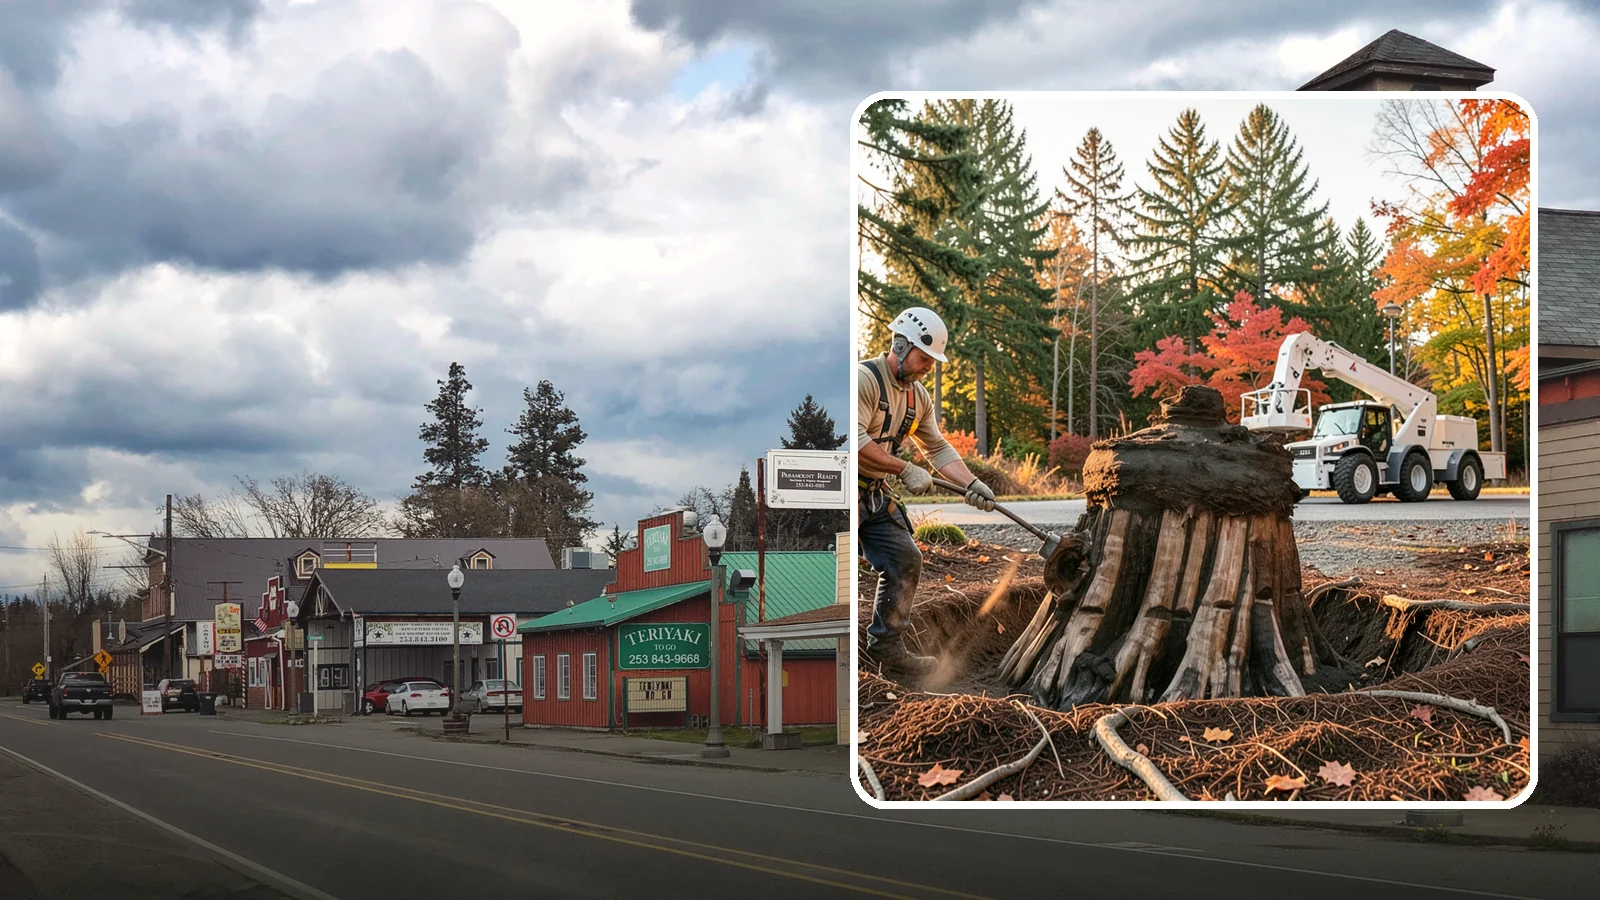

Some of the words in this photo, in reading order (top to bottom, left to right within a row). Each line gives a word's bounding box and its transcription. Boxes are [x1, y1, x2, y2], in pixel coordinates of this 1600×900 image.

[781, 471, 815, 479] PARAMOUNT
[817, 472, 839, 480] REALTY
[624, 627, 702, 646] TERIYAKI
[628, 654, 649, 665] 253
[651, 654, 700, 664] 843-9668
